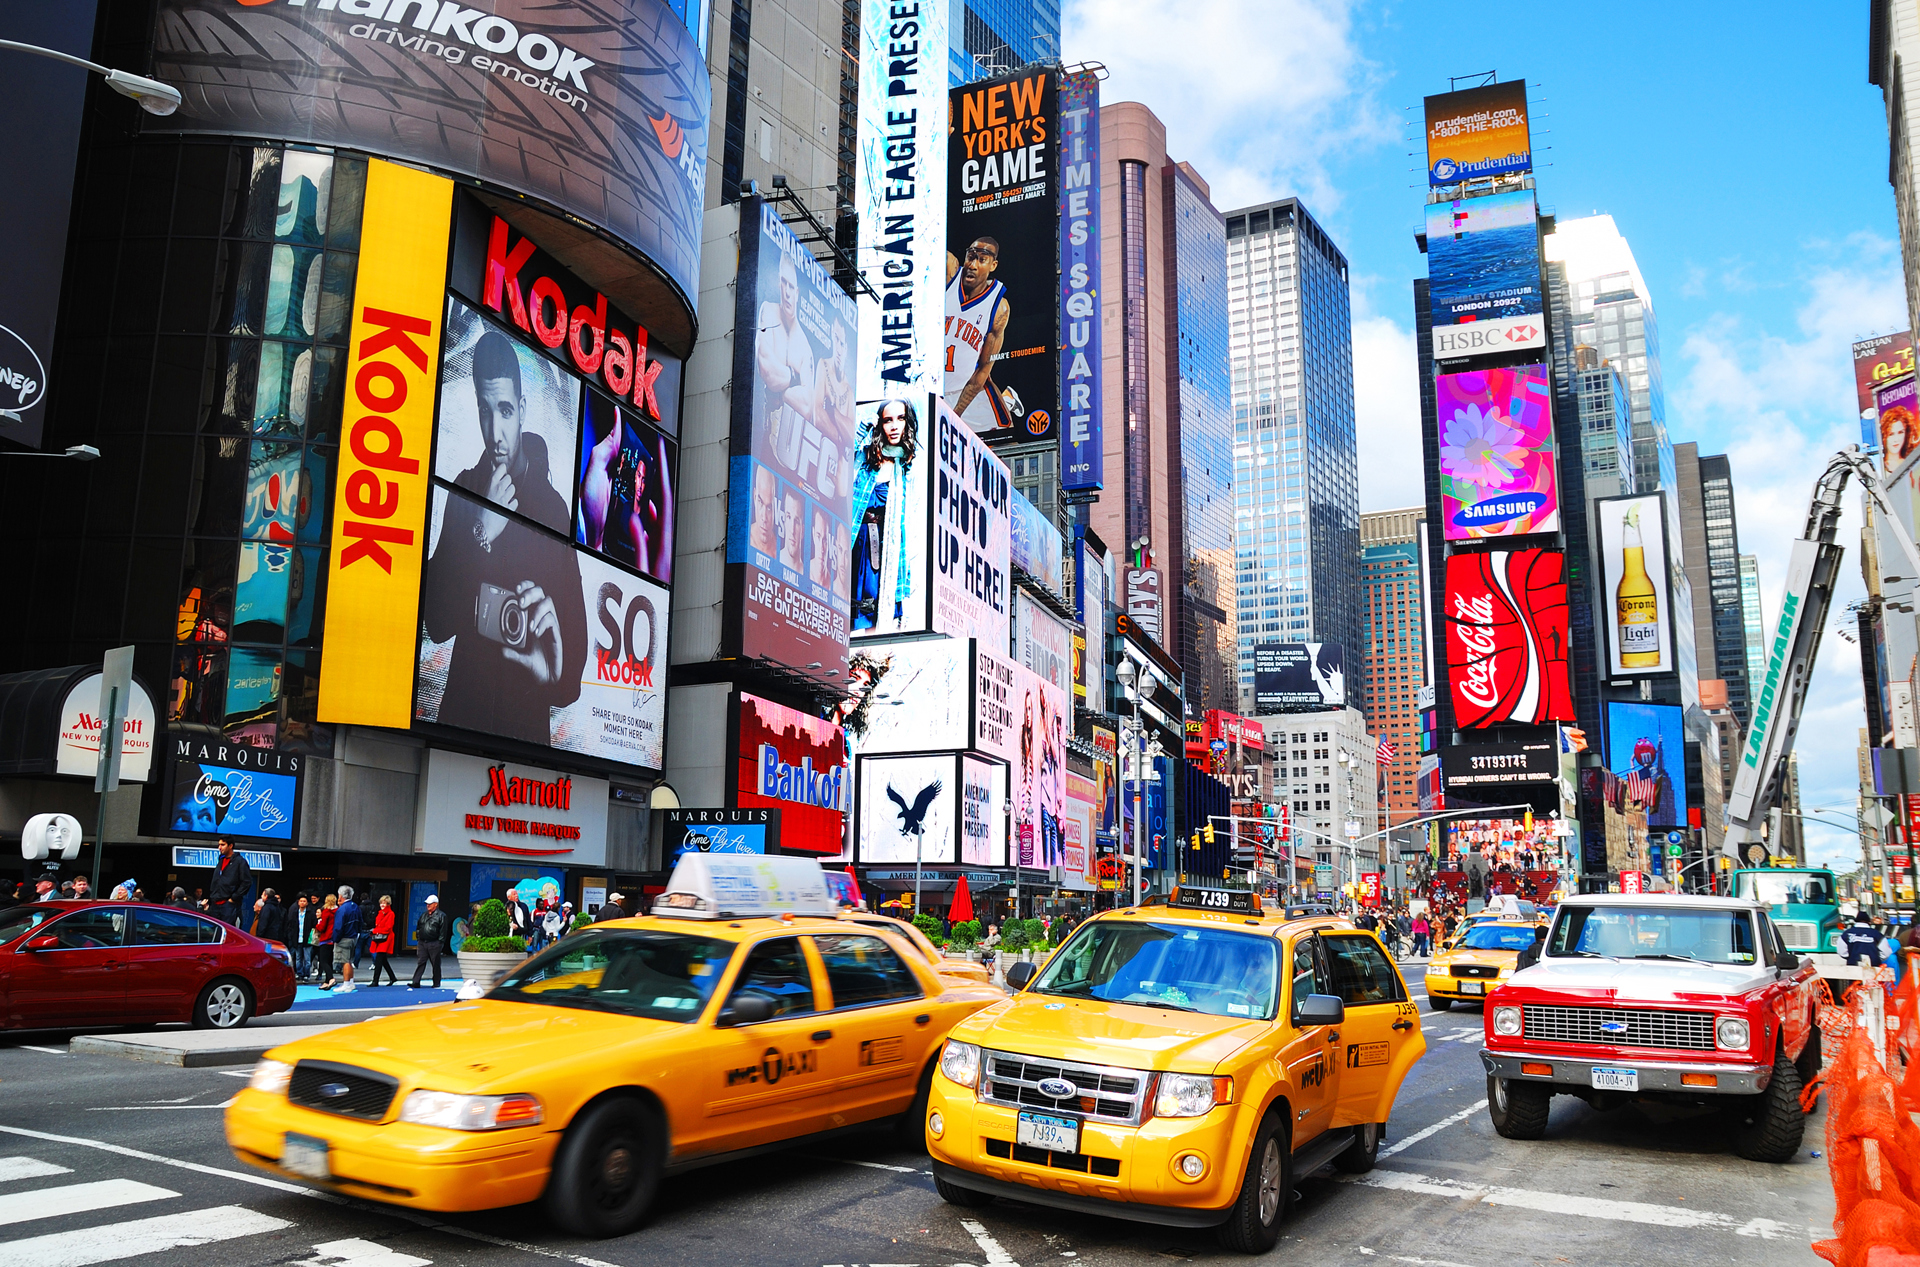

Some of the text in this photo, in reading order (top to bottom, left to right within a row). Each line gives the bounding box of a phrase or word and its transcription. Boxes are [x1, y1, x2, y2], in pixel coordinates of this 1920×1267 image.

[349, 21, 588, 112] driving emotion
[963, 74, 1046, 133] NEW
[1430, 114, 1524, 139] 1-800-THE-ROCK
[1435, 109, 1516, 131] prudential.com
[963, 116, 1046, 159] YORK'S
[886, 107, 917, 202] EAGLE
[1459, 151, 1528, 173] Prudential
[962, 143, 1046, 194] GAME
[963, 198, 975, 206] TEXT
[963, 205, 973, 214] FOR
[979, 200, 1000, 210] CHANCE
[1009, 195, 1024, 204] MEET
[763, 204, 858, 332] LESNAR VELASQUEZ
[1065, 107, 1094, 443] TIMES SQUARE
[881, 215, 914, 384] AMERICAN
[1440, 287, 1531, 305] WEMBLEY STADIUM
[1452, 301, 1491, 312] LONDON
[483, 215, 664, 421] Kodak
[1010, 346, 1046, 358] STOUDEMIRE
[1439, 328, 1501, 351] HSBC
[1853, 336, 1892, 351] NATHAN
[1854, 348, 1877, 359] LANE
[340, 306, 432, 575] Kodak
[777, 403, 839, 499] UFC
[940, 415, 1008, 519] GET YOUR
[1070, 463, 1090, 473] NYC
[940, 469, 987, 549] PHOTO
[1464, 501, 1536, 518] SAMSUNG
[939, 524, 1004, 614] UP HERE!
[748, 584, 772, 608] LIVE
[774, 598, 790, 617] ON
[757, 573, 781, 598] SAT.
[785, 587, 831, 623] OCTOBER
[833, 613, 844, 630] 23
[593, 582, 657, 674] SO
[1624, 626, 1654, 641] Light
[597, 649, 653, 688] Kodak
[979, 653, 1013, 688] STEP INSIDE
[1745, 591, 1799, 769] LANDMARK
[979, 675, 1007, 703] FOR YOUR
[592, 707, 653, 732] SHARE YOUR SO KODAK
[980, 699, 1013, 729] 15 SECONDS
[62, 732, 82, 740] NEW
[603, 722, 643, 741] MOMENT HERE
[979, 723, 1003, 747] OF FAME
[177, 741, 299, 771] MARQUIS
[479, 766, 572, 810] Marriott
[758, 744, 819, 806] Bank
[817, 765, 841, 811] of
[194, 771, 287, 831] Come Fly Away
[964, 783, 990, 804] AMERICAN
[670, 811, 768, 822] MARQUIS
[964, 803, 980, 820] EAGLE
[465, 814, 581, 841] NEW YORK MARQUIS
[683, 828, 710, 850] Come
[702, 826, 728, 852] Fly
[964, 819, 989, 839] PRESENTS
[246, 853, 275, 868] SINATRA
[1201, 891, 1229, 907] 7J39
[1395, 1003, 1417, 1015] 7J39
[1046, 1083, 1065, 1094] Ford
[1301, 1069, 1315, 1090] NYC
[978, 1120, 1016, 1132] ESCAPE
